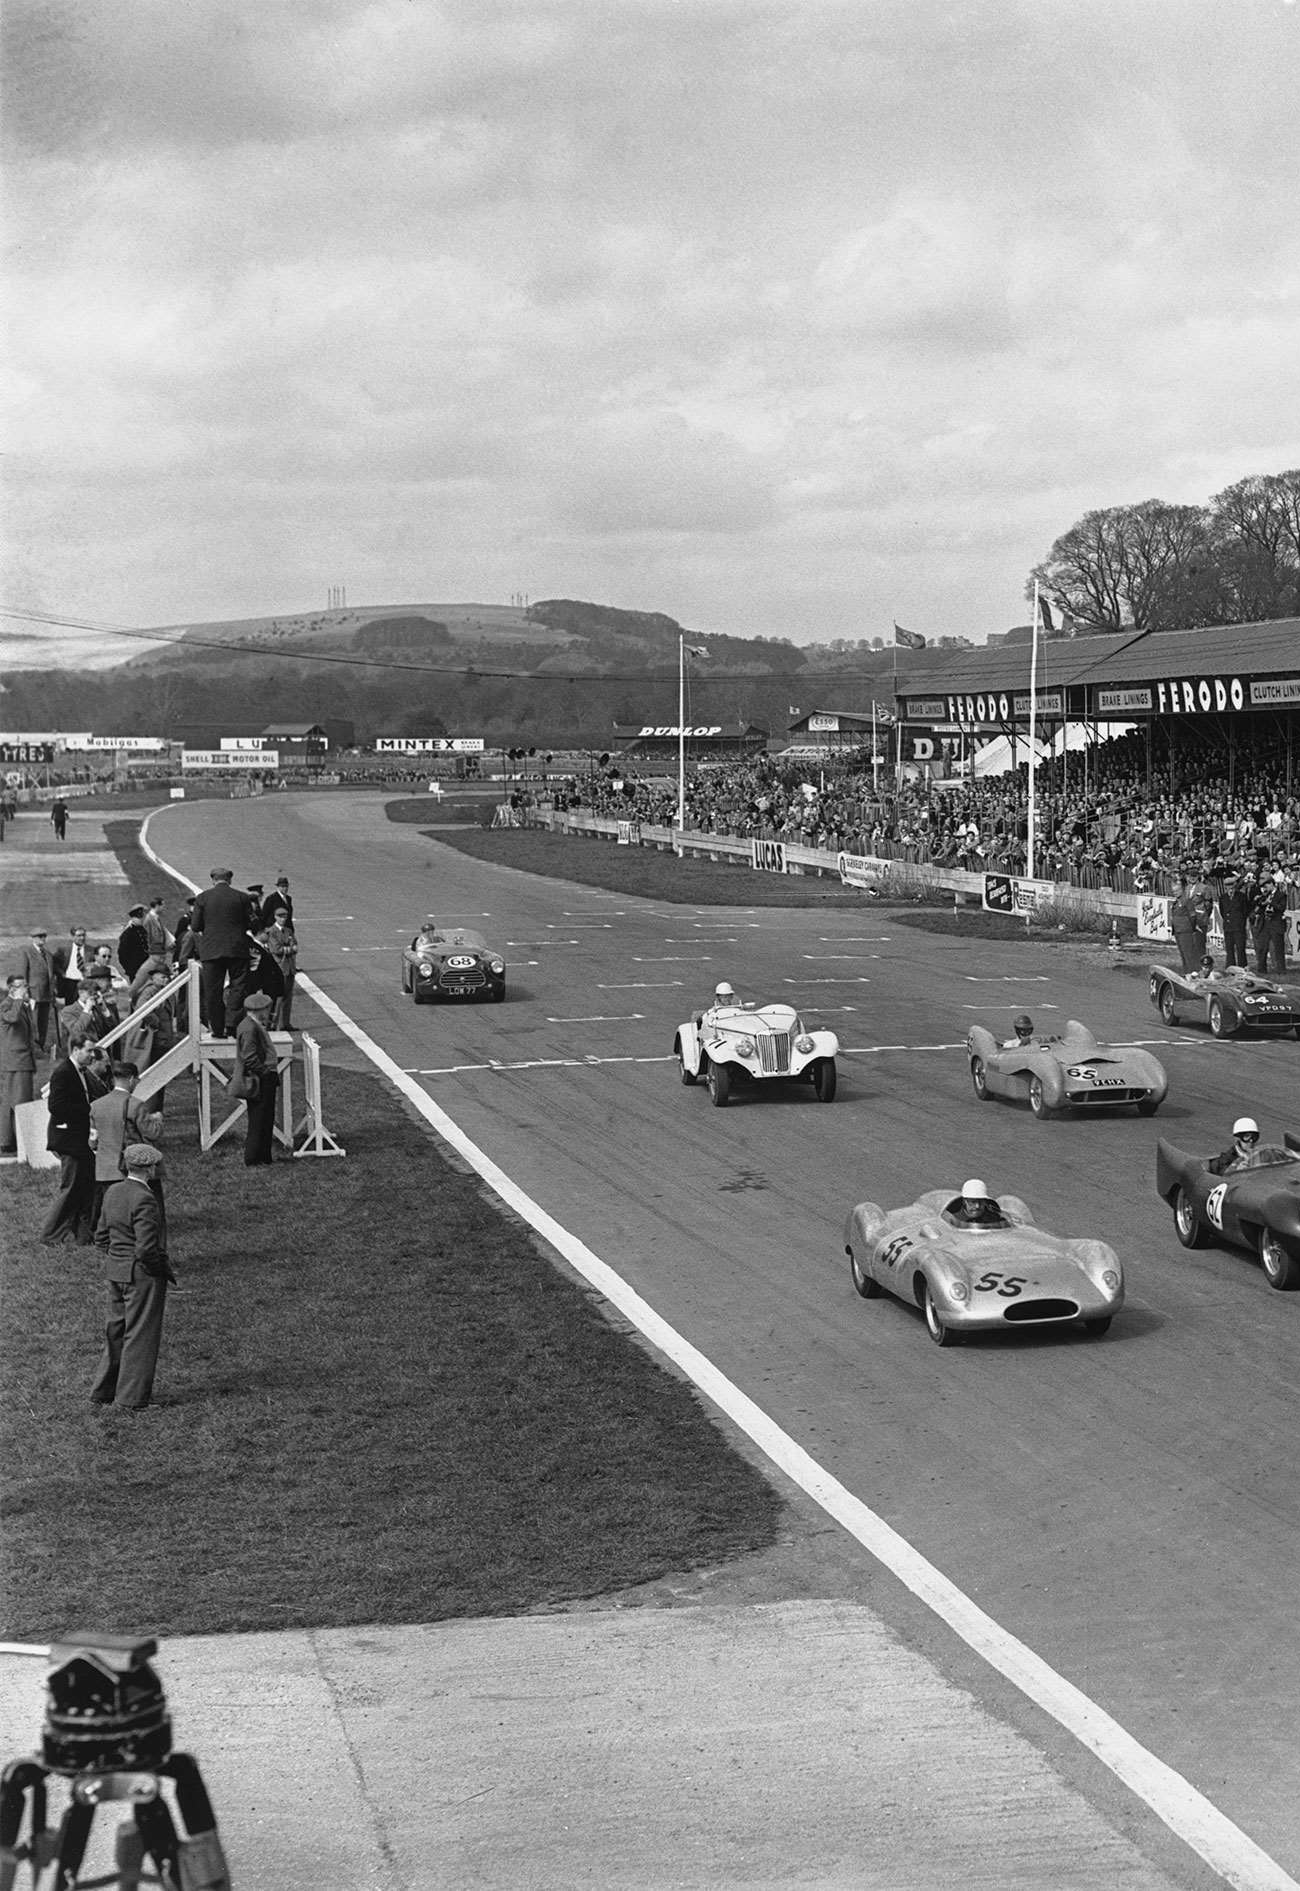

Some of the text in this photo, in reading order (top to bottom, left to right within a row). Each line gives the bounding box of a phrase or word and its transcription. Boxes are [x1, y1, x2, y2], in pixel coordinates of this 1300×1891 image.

[1101, 692, 1149, 706] BRAKE LININGS
[1157, 678, 1243, 713] FERODO
[1253, 685, 1280, 699] CLUTCH
[948, 693, 1009, 721] FERODO
[638, 726, 722, 736] DUNLOP
[381, 740, 455, 749] MINTEX
[185, 755, 209, 763] SHELL
[232, 755, 260, 763] MOTOR
[262, 755, 276, 763] OIL
[754, 841, 784, 873] LUCAS
[451, 956, 472, 966] 68
[1245, 996, 1269, 1005] 64
[1066, 1067, 1097, 1080] 65
[881, 1236, 914, 1267] 55
[974, 1272, 1028, 1297] 55
